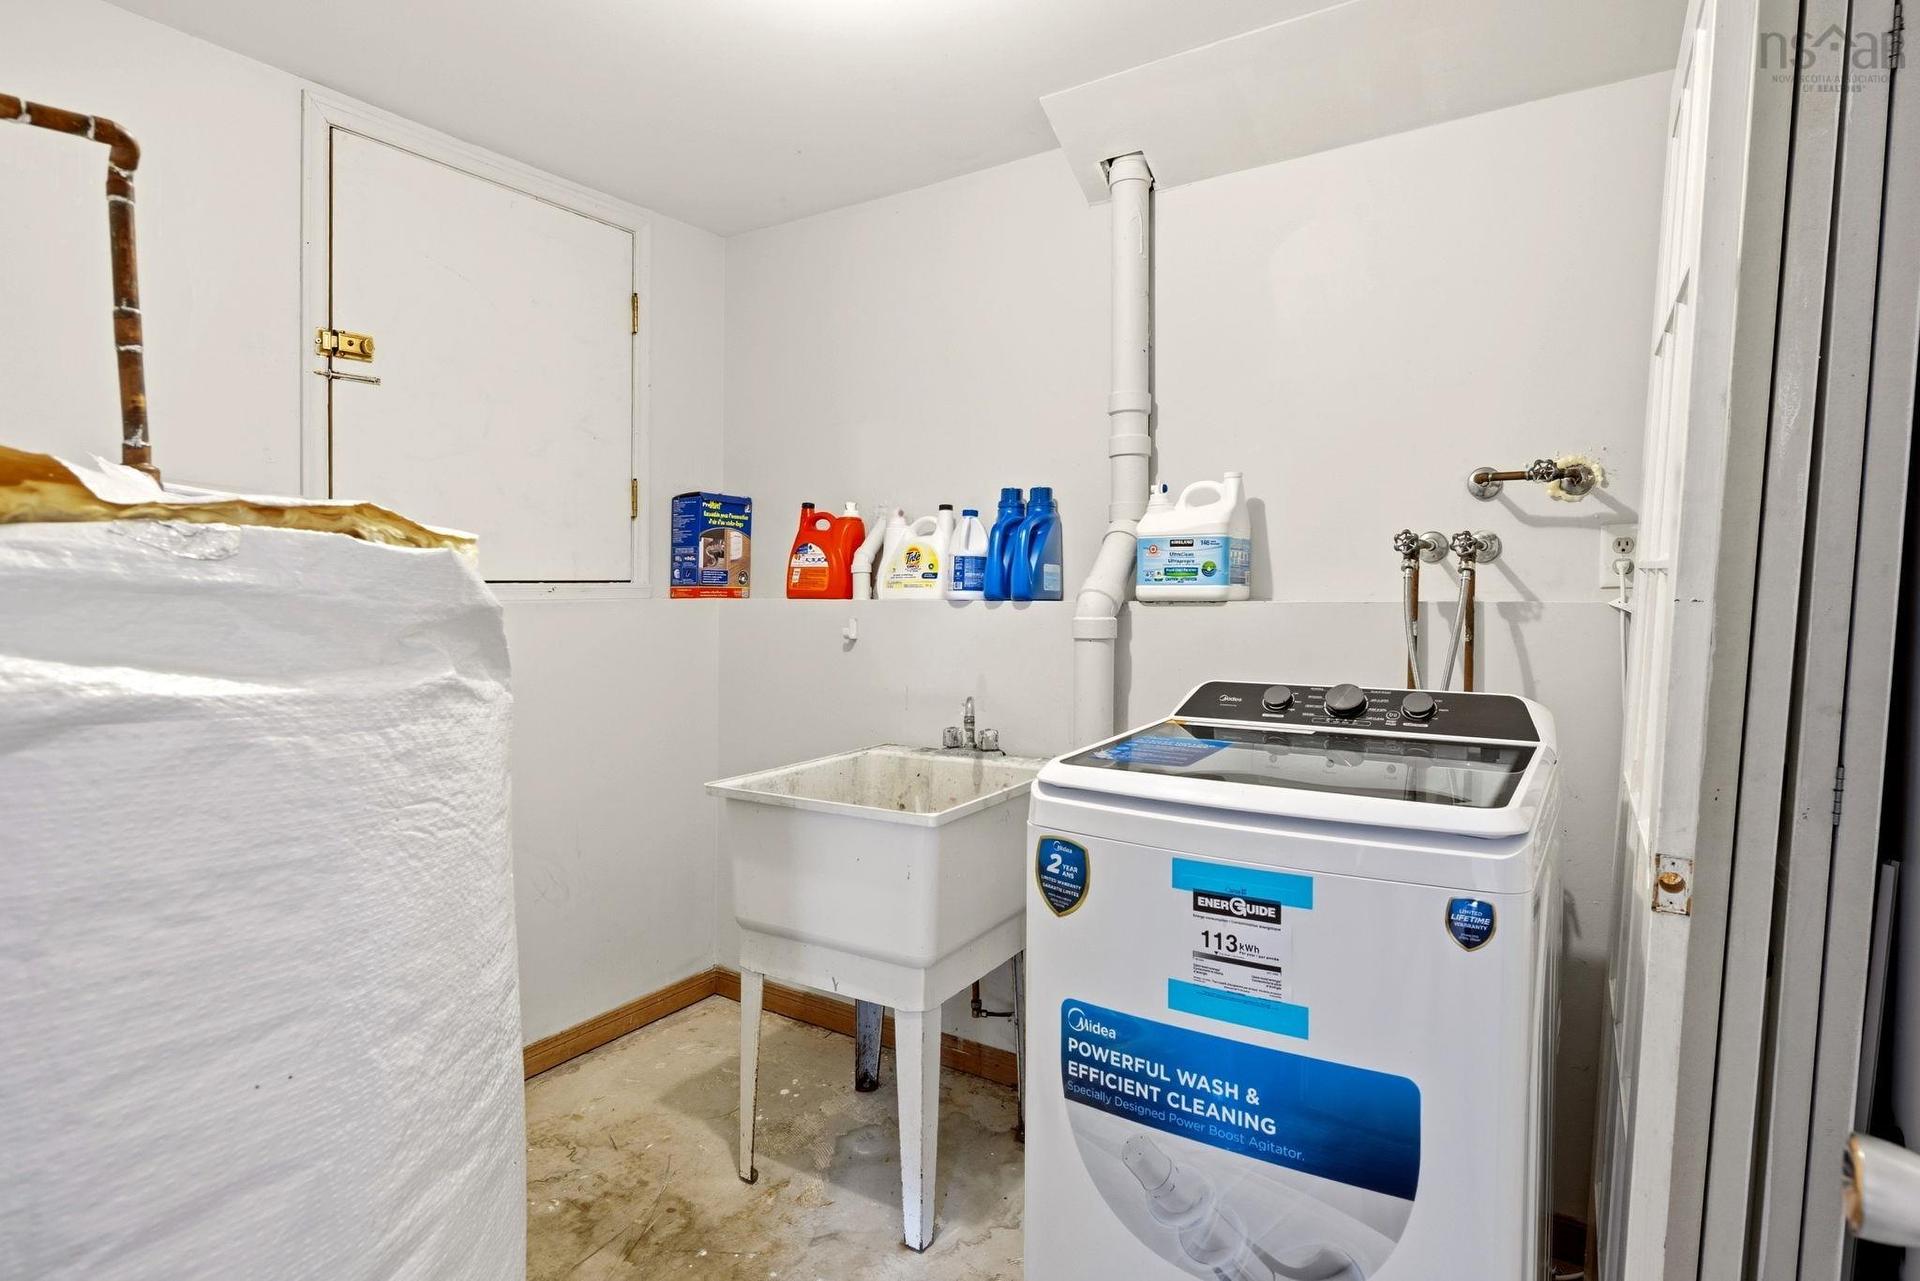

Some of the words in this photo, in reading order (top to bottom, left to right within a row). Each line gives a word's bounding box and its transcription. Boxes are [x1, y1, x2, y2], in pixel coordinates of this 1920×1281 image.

[1046, 853, 1062, 874] 2
[1062, 864, 1078, 873] YEAR
[1062, 871, 1074, 880] ANS
[1451, 913, 1491, 925] LIFETIME
[1454, 921, 1487, 930] WARRANTY
[1202, 930, 1238, 953] 113
[1239, 943, 1260, 954] kWh
[1068, 1007, 1116, 1040] Midea
[1068, 1036, 1171, 1082] POWERFUL
[1176, 1068, 1239, 1101] WASH
[1245, 1087, 1260, 1105] &
[1068, 1060, 1161, 1102] EFFICIENT
[1166, 1092, 1276, 1135] CLEANING
[1067, 1081, 1111, 1105] Specially
[1115, 1096, 1165, 1121] Designed
[1169, 1112, 1206, 1132] Power
[1209, 1125, 1245, 1145] Boost
[1249, 1136, 1305, 1161] Agitator.
